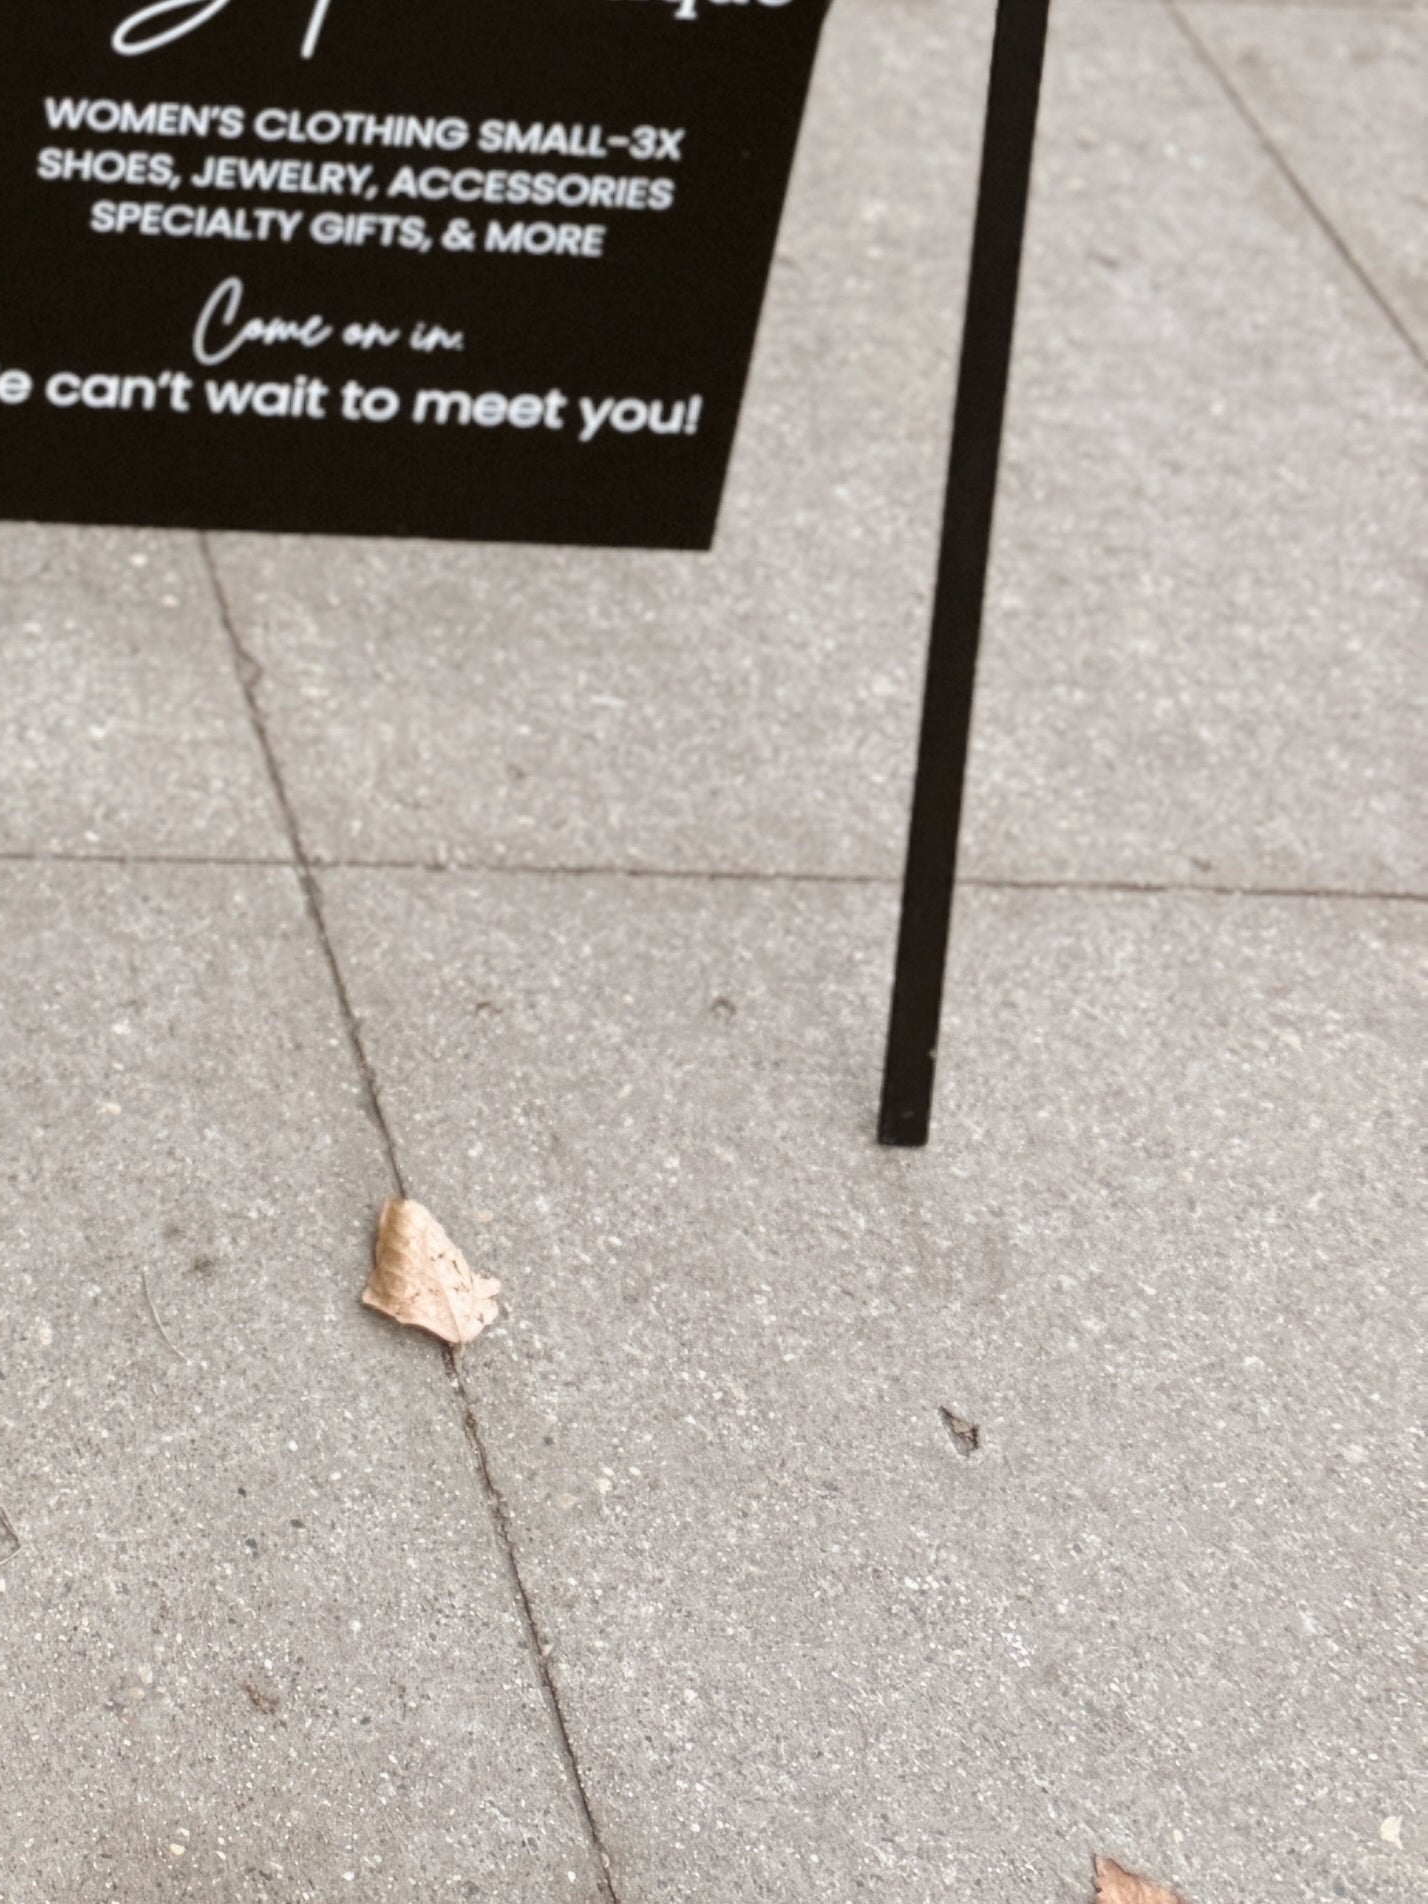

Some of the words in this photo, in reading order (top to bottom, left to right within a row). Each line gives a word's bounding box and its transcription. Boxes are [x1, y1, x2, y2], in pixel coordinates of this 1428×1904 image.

[44, 96, 245, 139] WOMEN'S
[253, 107, 470, 151] CLOTHING
[477, 118, 685, 161] SMALL-3X
[36, 146, 181, 191] SHOES,
[190, 155, 379, 201] JEWELRY,
[387, 165, 675, 211] ACCESSORIES
[90, 199, 303, 242] SPECIALTY
[309, 211, 433, 253] GIFTS,
[440, 217, 476, 251] &
[484, 220, 606, 258] MORE
[191, 276, 333, 366] Come
[342, 322, 400, 349] on
[44, 370, 193, 412] can't
[204, 374, 329, 419] wait
[340, 379, 400, 422] to
[412, 388, 568, 430] meet
[579, 394, 703, 442] you!
